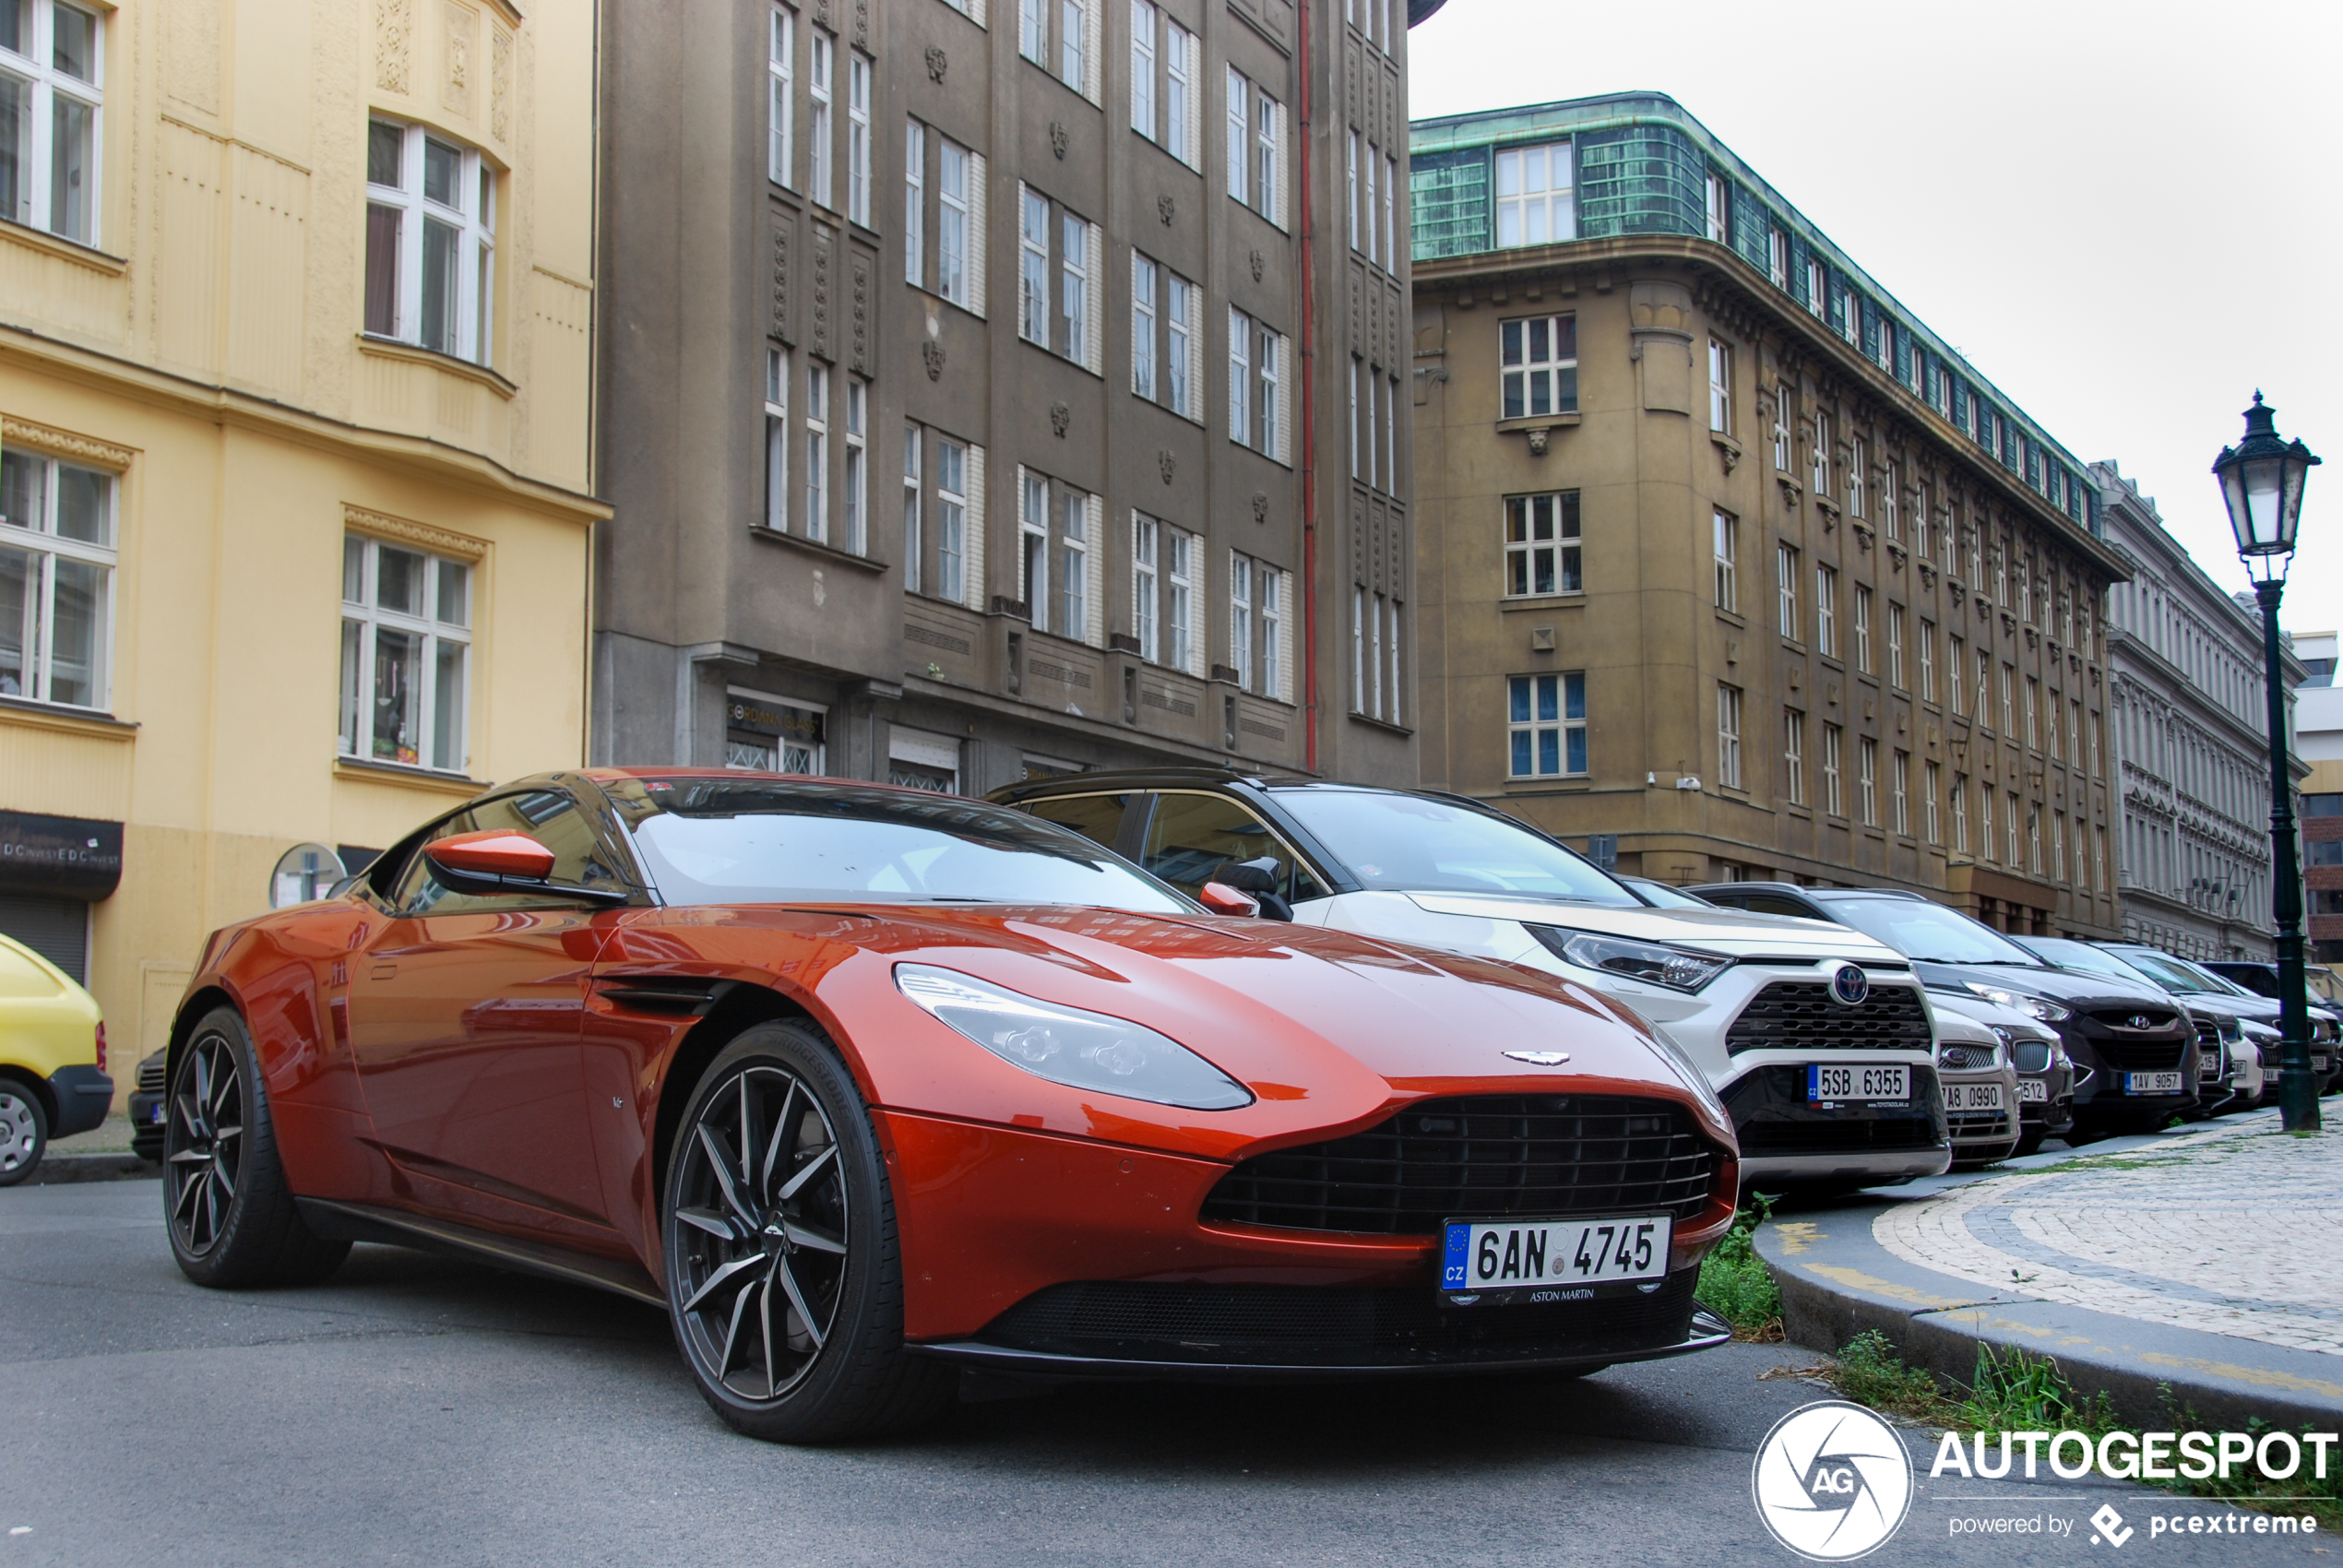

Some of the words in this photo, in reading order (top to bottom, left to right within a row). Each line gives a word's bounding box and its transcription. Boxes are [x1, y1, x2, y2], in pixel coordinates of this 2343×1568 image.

[727, 703, 780, 727] GORDANA
[783, 714, 816, 734] GLASS
[26, 849, 56, 859] INVEST
[89, 855, 118, 864] INVEST
[1822, 1069, 1850, 1096] 5SB
[1863, 1069, 1902, 1096] 6355
[2133, 1074, 2149, 1088] 1AV
[2155, 1074, 2177, 1088] 9057
[1969, 1087, 1998, 1107] 0990
[1445, 1266, 1464, 1281] CZ
[1477, 1229, 1548, 1280] 6AN
[1574, 1223, 1655, 1276] 4745
[1529, 1290, 1560, 1302] ASTON
[1561, 1289, 1595, 1301] MARTIN
